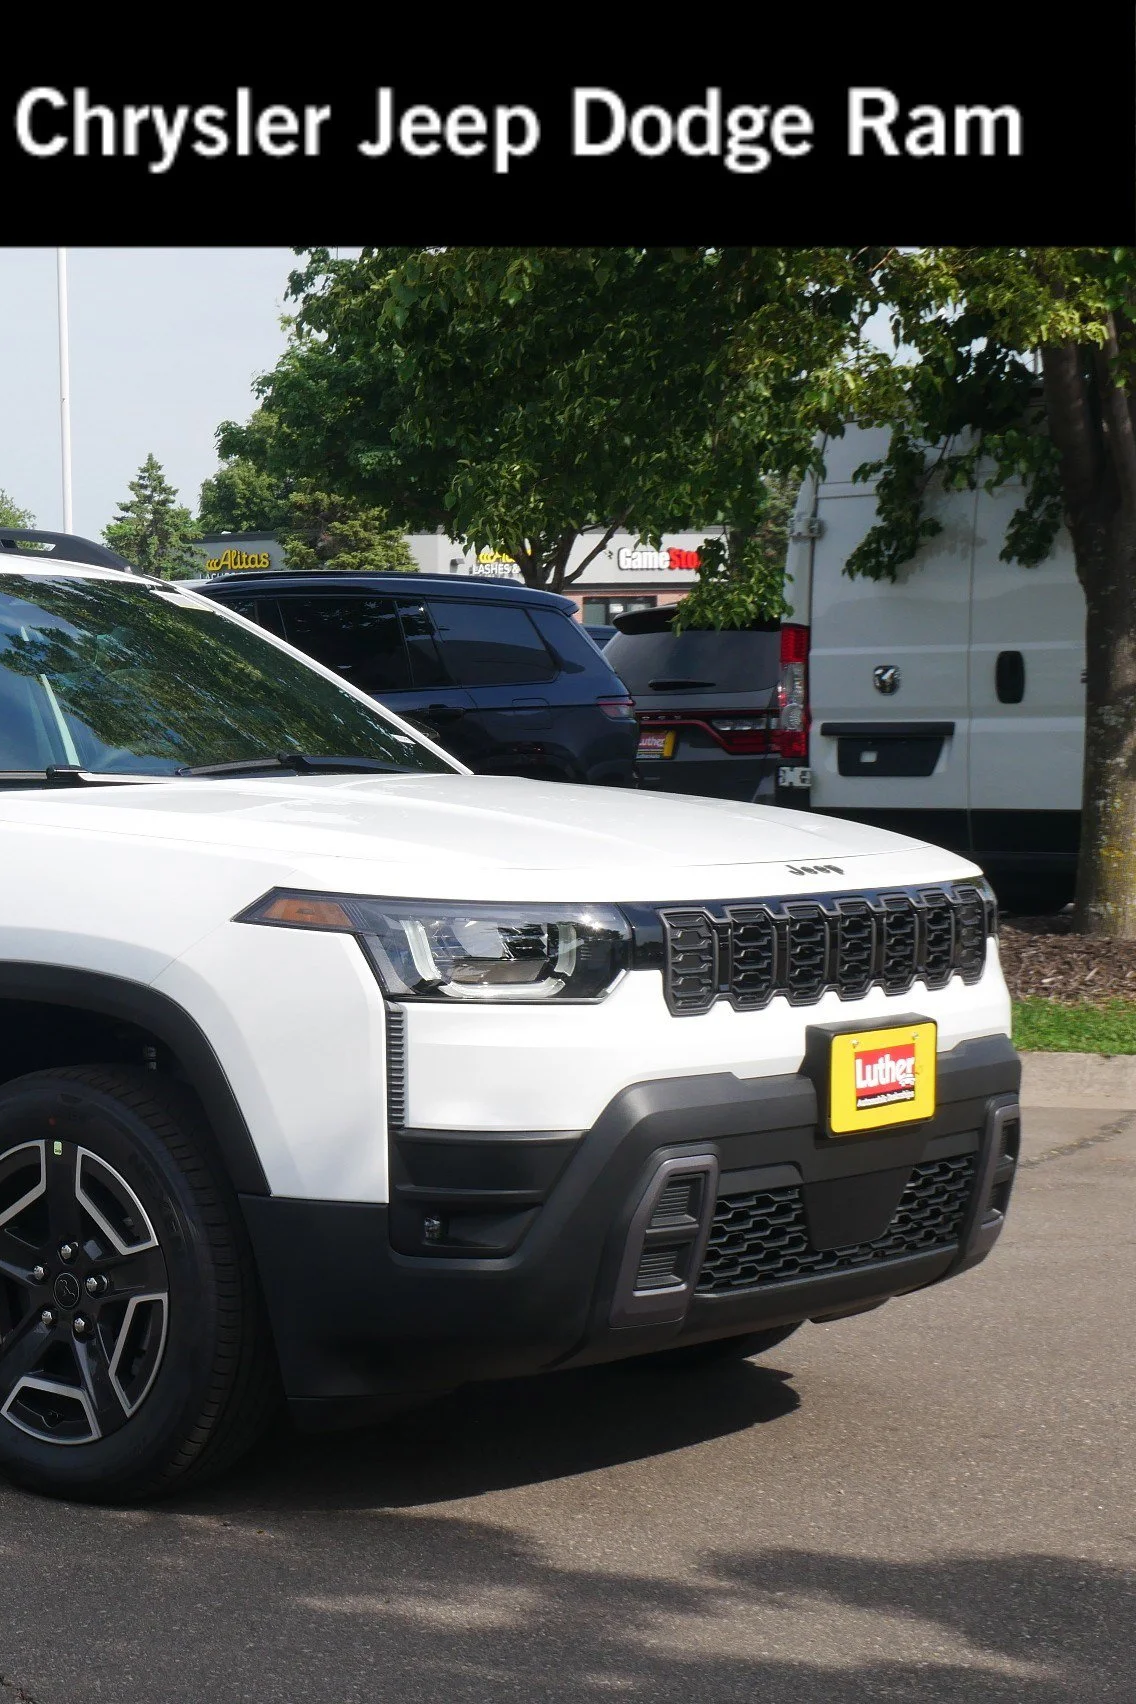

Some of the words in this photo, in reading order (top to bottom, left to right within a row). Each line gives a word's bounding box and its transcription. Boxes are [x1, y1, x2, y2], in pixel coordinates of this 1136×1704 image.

[206, 549, 271, 571] Alitas
[472, 563, 511, 574] LASHES
[618, 547, 702, 571] GameSto
[783, 864, 845, 876] Jeep
[855, 1053, 916, 1089] Luther
